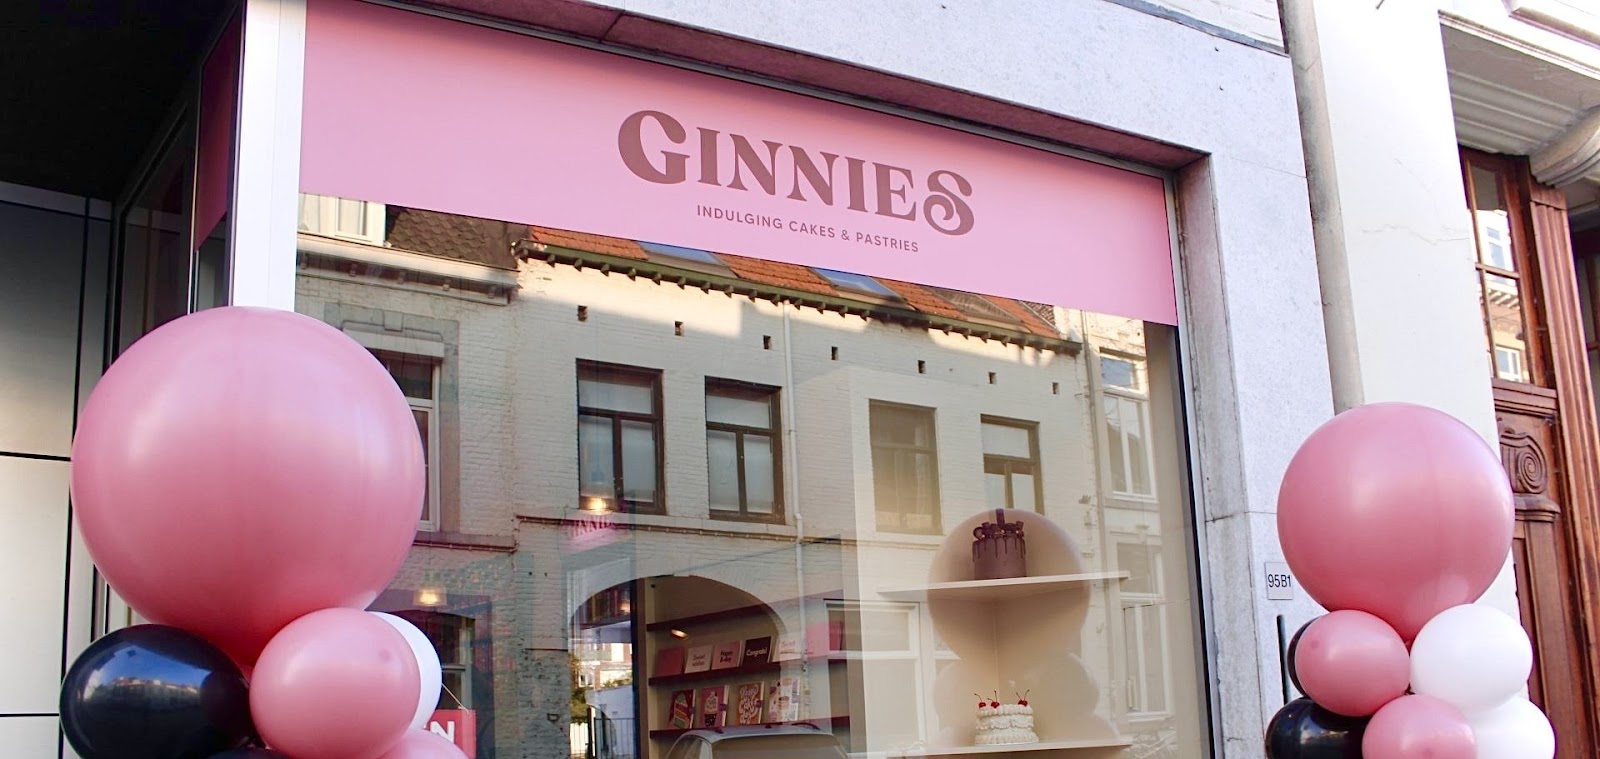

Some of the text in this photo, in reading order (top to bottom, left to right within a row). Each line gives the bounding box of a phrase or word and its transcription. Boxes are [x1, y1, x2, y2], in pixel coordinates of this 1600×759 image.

[617, 109, 975, 237] GINNIES
[696, 204, 919, 253] INDULGING CAKES & PASTRIES
[1267, 573, 1292, 588] 95B1
